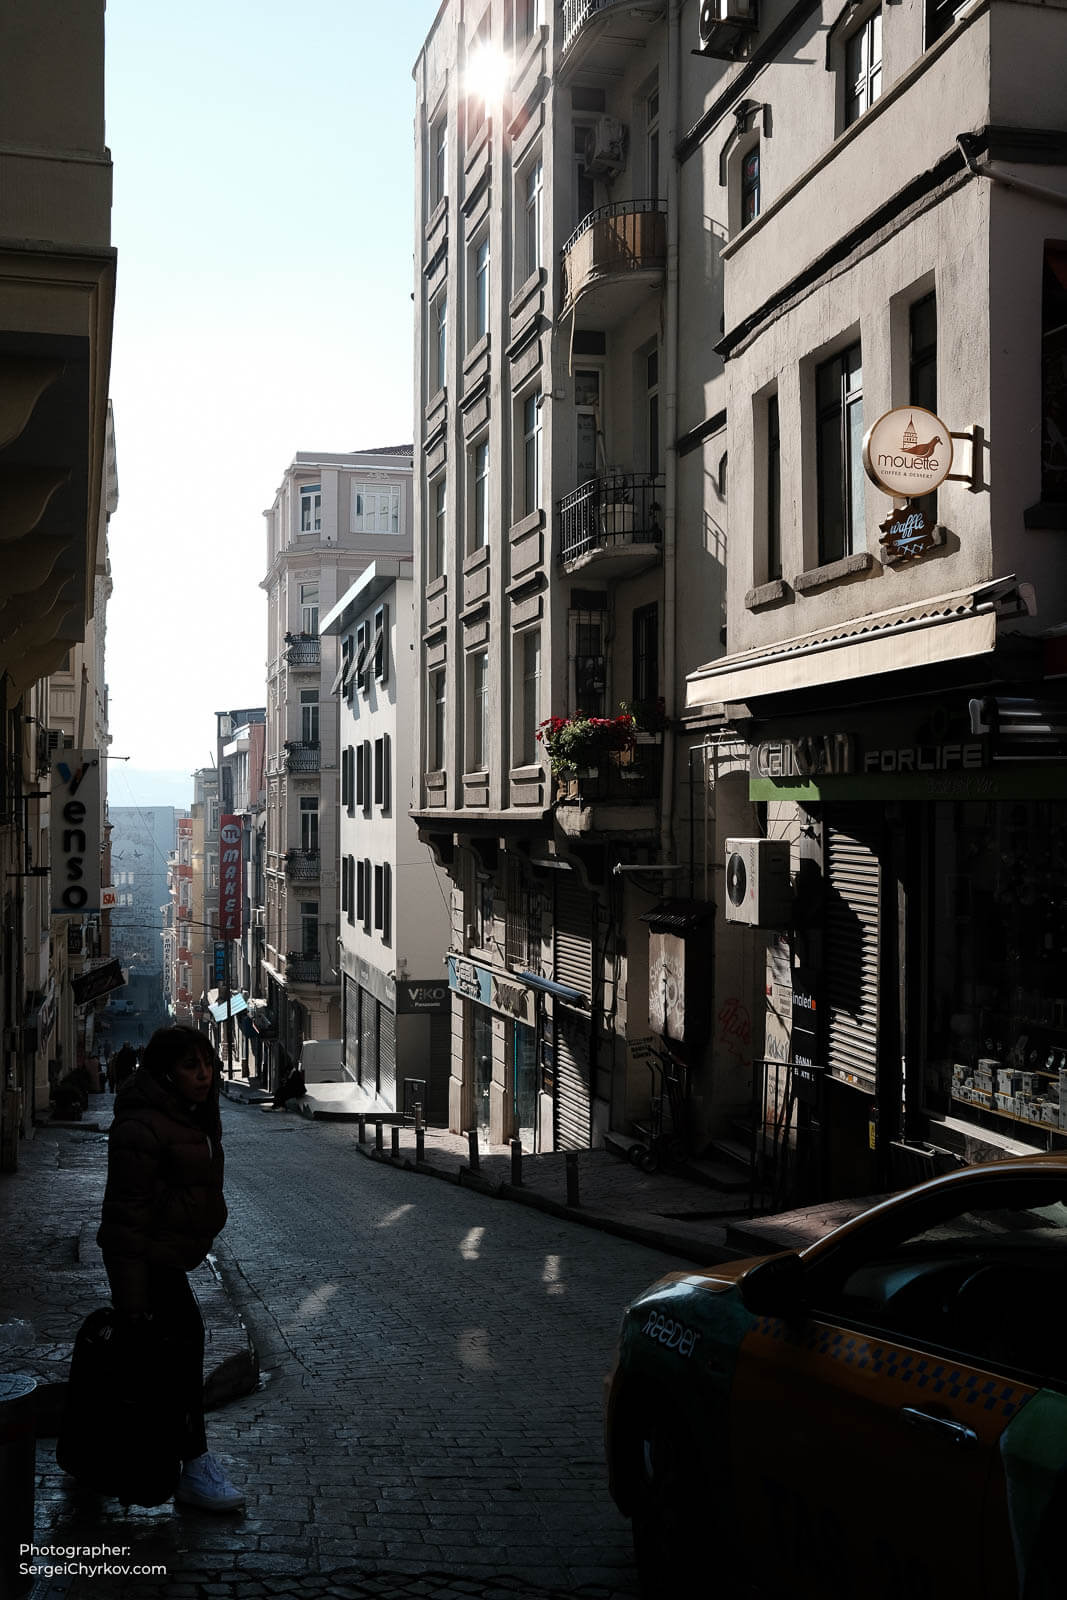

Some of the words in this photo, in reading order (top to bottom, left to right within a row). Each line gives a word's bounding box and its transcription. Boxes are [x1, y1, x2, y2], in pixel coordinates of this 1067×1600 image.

[878, 453, 939, 472] mouette
[880, 469, 902, 477] COFFEE
[908, 472, 933, 480] DESSERT
[890, 513, 925, 539] waffle
[863, 743, 983, 773] FORLIFE
[222, 848, 240, 930] MAKEL
